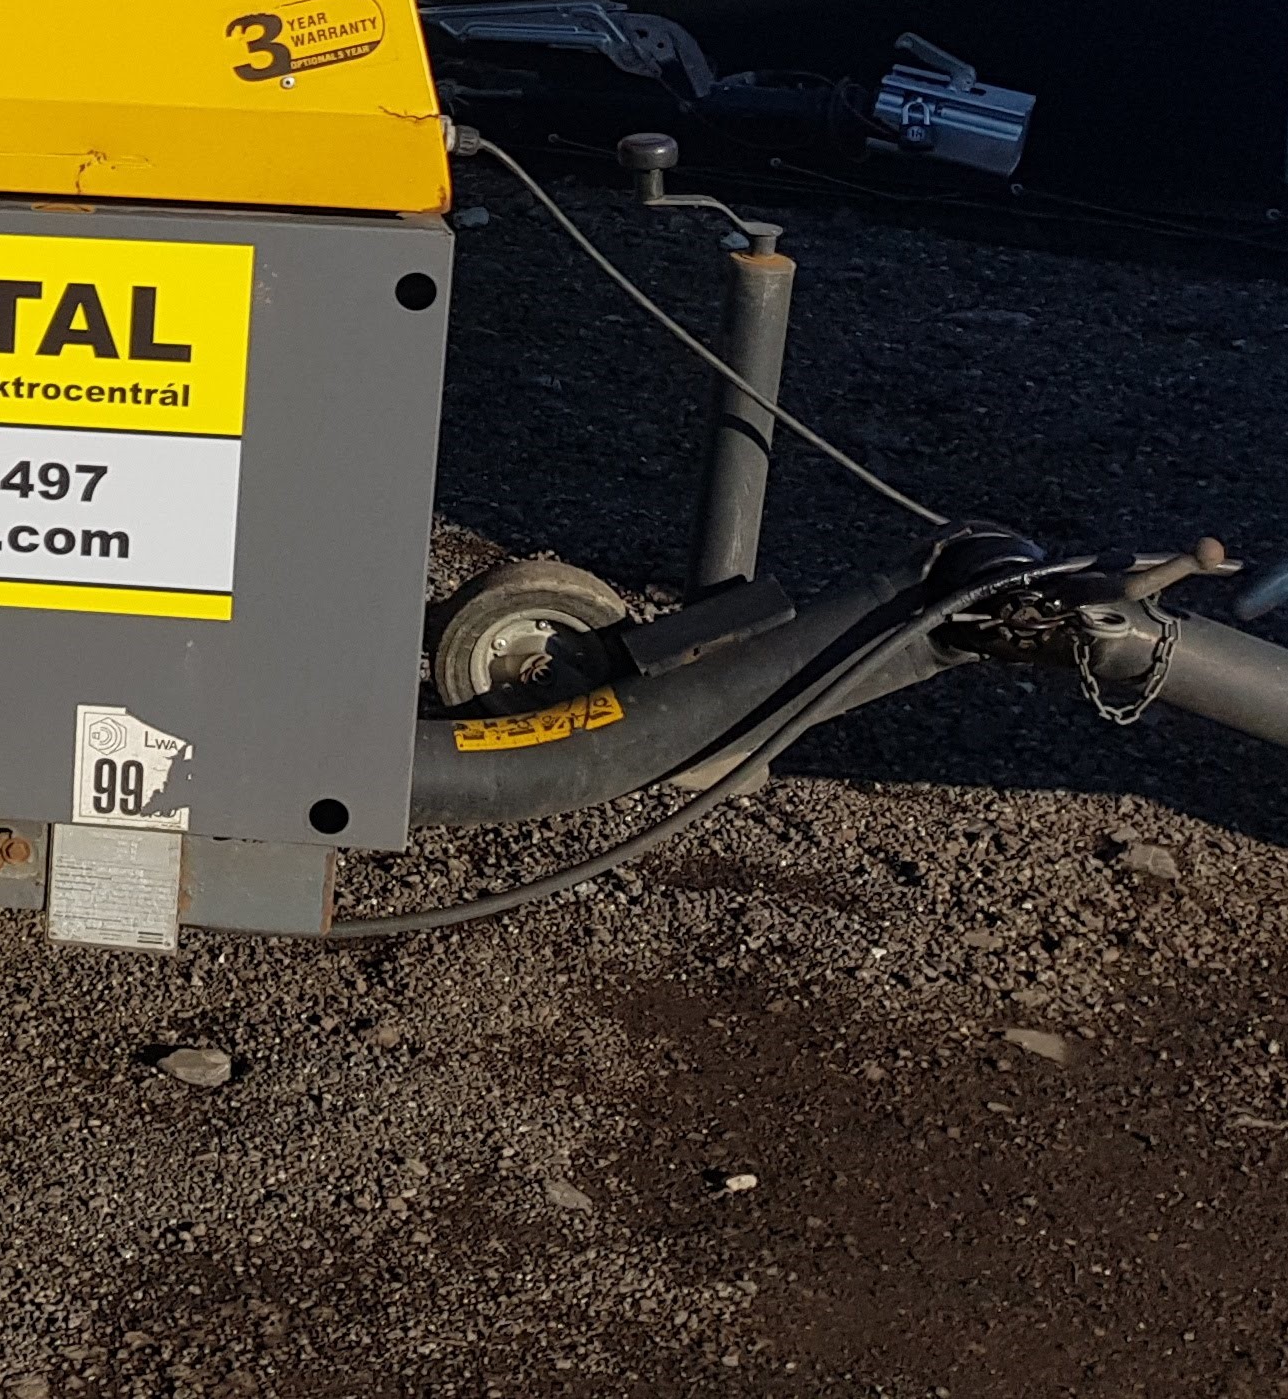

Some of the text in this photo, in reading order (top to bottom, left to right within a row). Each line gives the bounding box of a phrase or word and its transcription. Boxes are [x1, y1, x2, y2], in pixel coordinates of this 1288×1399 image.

[286, 11, 328, 32] YEAR
[290, 16, 378, 48] WARRANTY
[225, 12, 292, 82] 3
[0, 460, 110, 503] 497
[92, 757, 145, 817] 99
